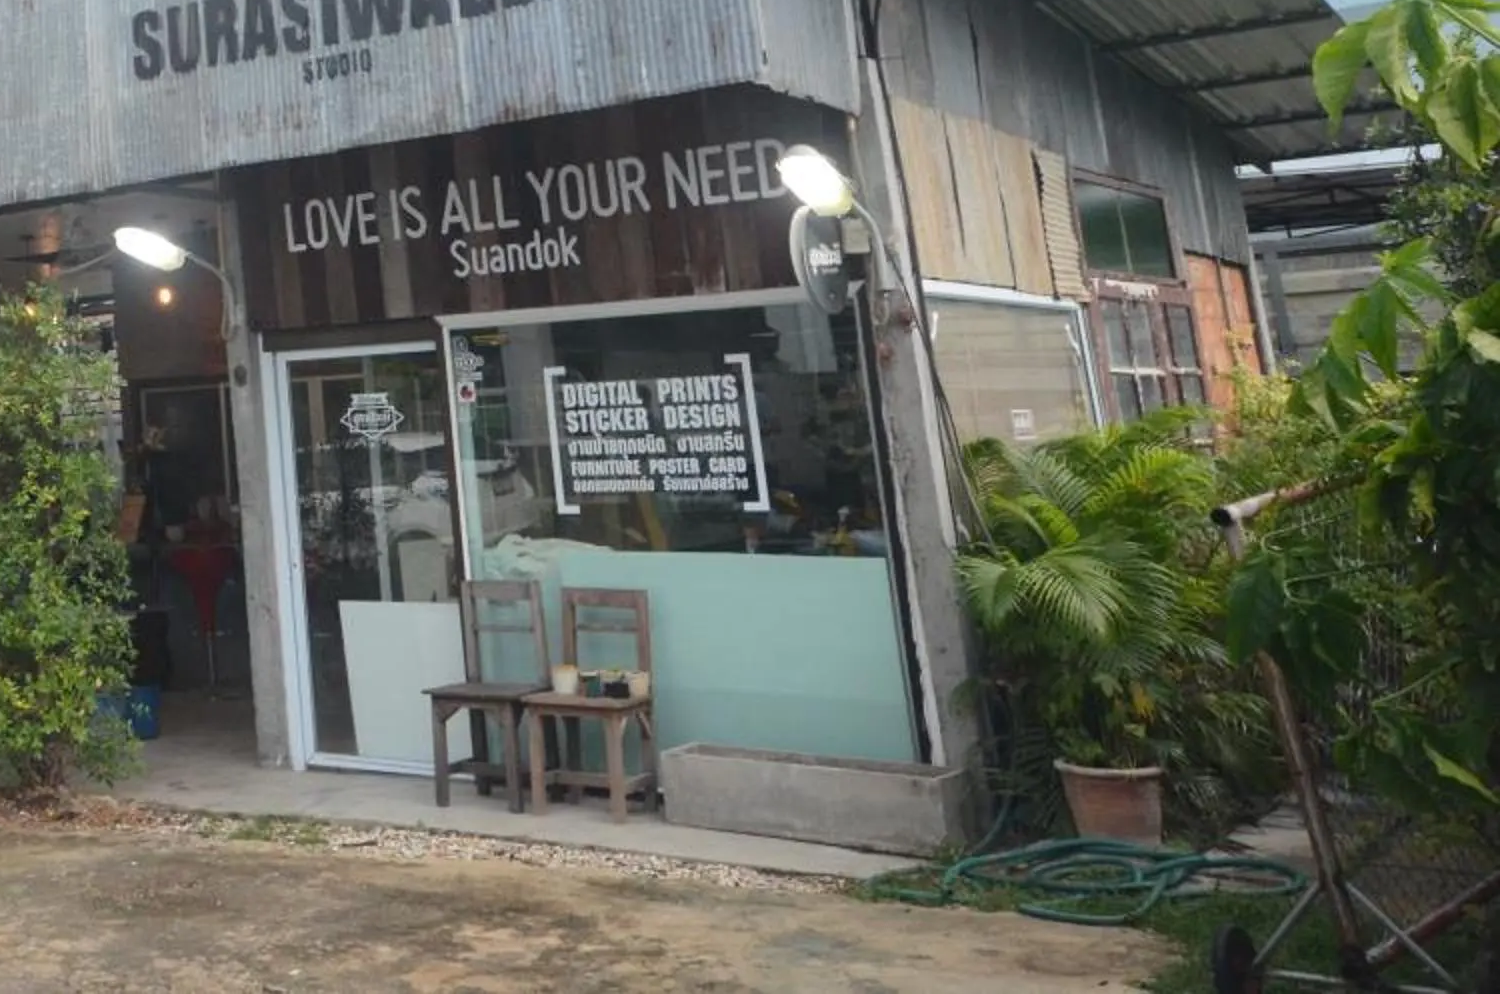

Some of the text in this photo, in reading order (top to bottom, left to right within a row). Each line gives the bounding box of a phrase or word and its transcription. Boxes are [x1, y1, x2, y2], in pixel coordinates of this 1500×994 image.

[302, 48, 373, 84] STUDIO
[285, 138, 790, 253] LOVE IS ALL YOUR NEED
[451, 229, 581, 279] Suandok
[562, 374, 738, 408] DIGITAL PRINTS
[565, 403, 741, 434] STICKER DESIGN
[571, 456, 747, 477] FURNITURE POSTER CARD
